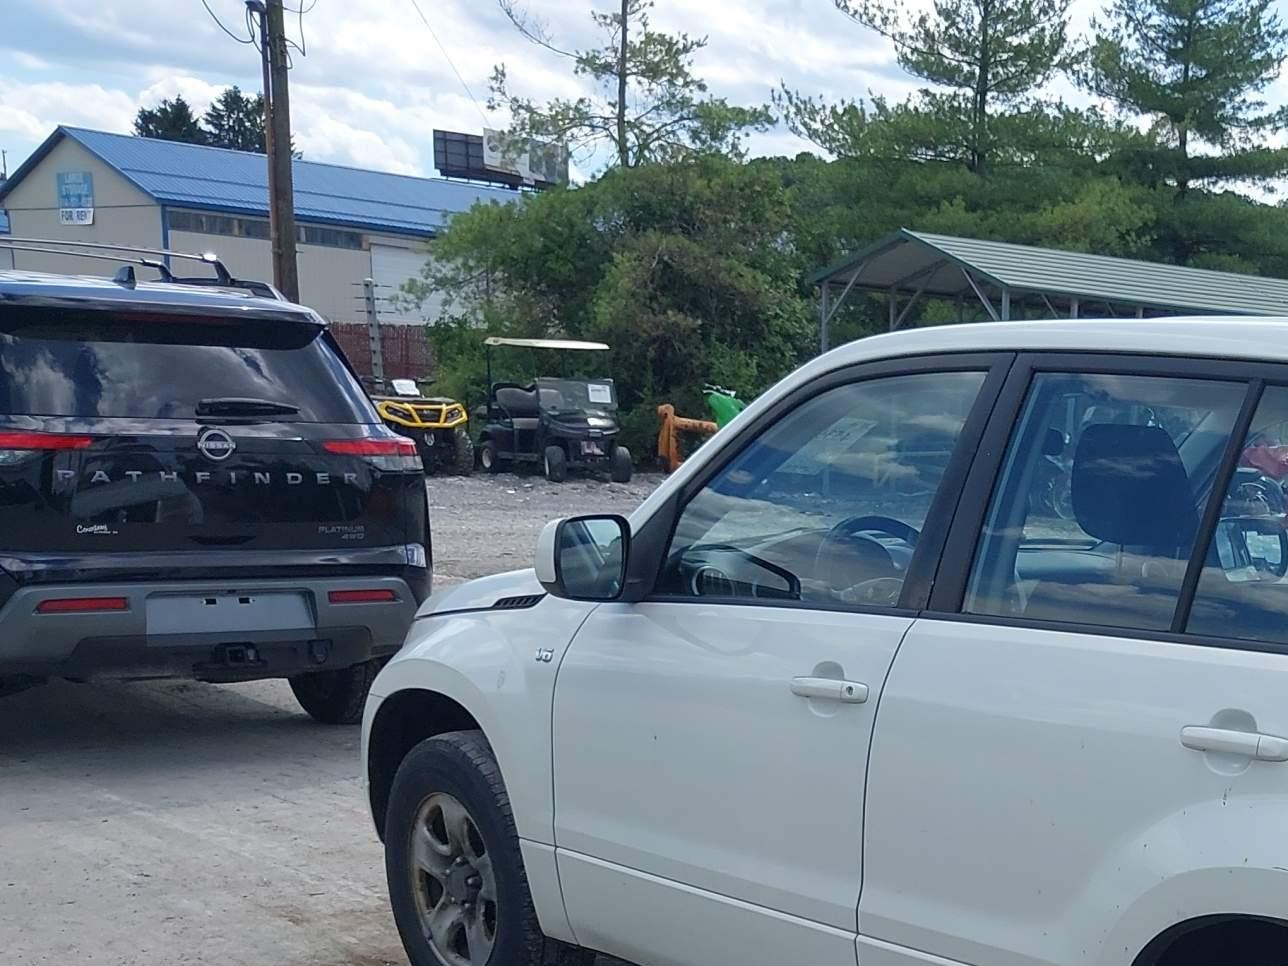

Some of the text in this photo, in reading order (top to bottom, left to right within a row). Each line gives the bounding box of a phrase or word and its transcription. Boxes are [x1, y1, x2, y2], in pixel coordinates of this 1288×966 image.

[61, 210, 92, 221] FOR RENT
[197, 440, 236, 449] NISSAN
[56, 469, 357, 485] PATHFINDER
